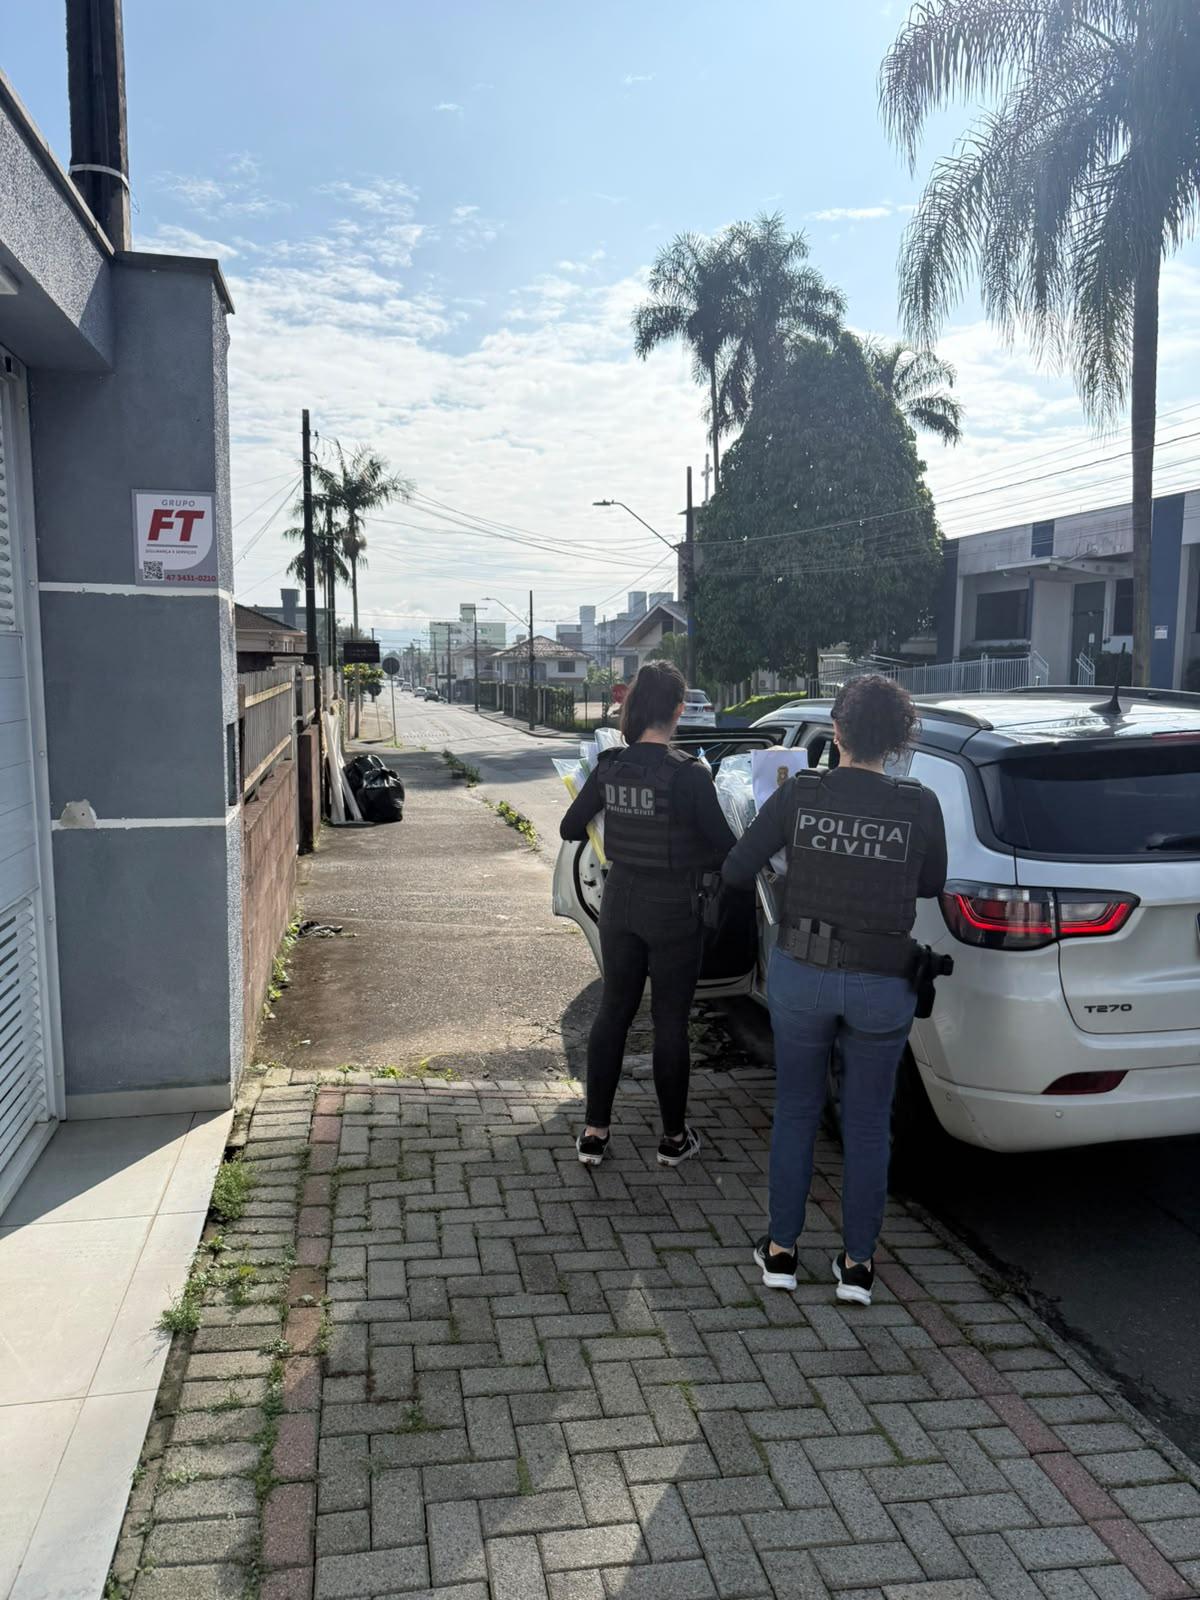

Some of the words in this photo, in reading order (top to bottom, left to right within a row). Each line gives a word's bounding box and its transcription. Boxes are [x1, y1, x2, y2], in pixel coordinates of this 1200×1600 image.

[161, 499, 195, 507] GRUPO
[147, 508, 205, 542] FT
[605, 783, 653, 809] DEIC
[799, 814, 904, 844] POLÍCIA
[811, 835, 888, 859] CIVIL
[1084, 1003, 1132, 1013] T270
